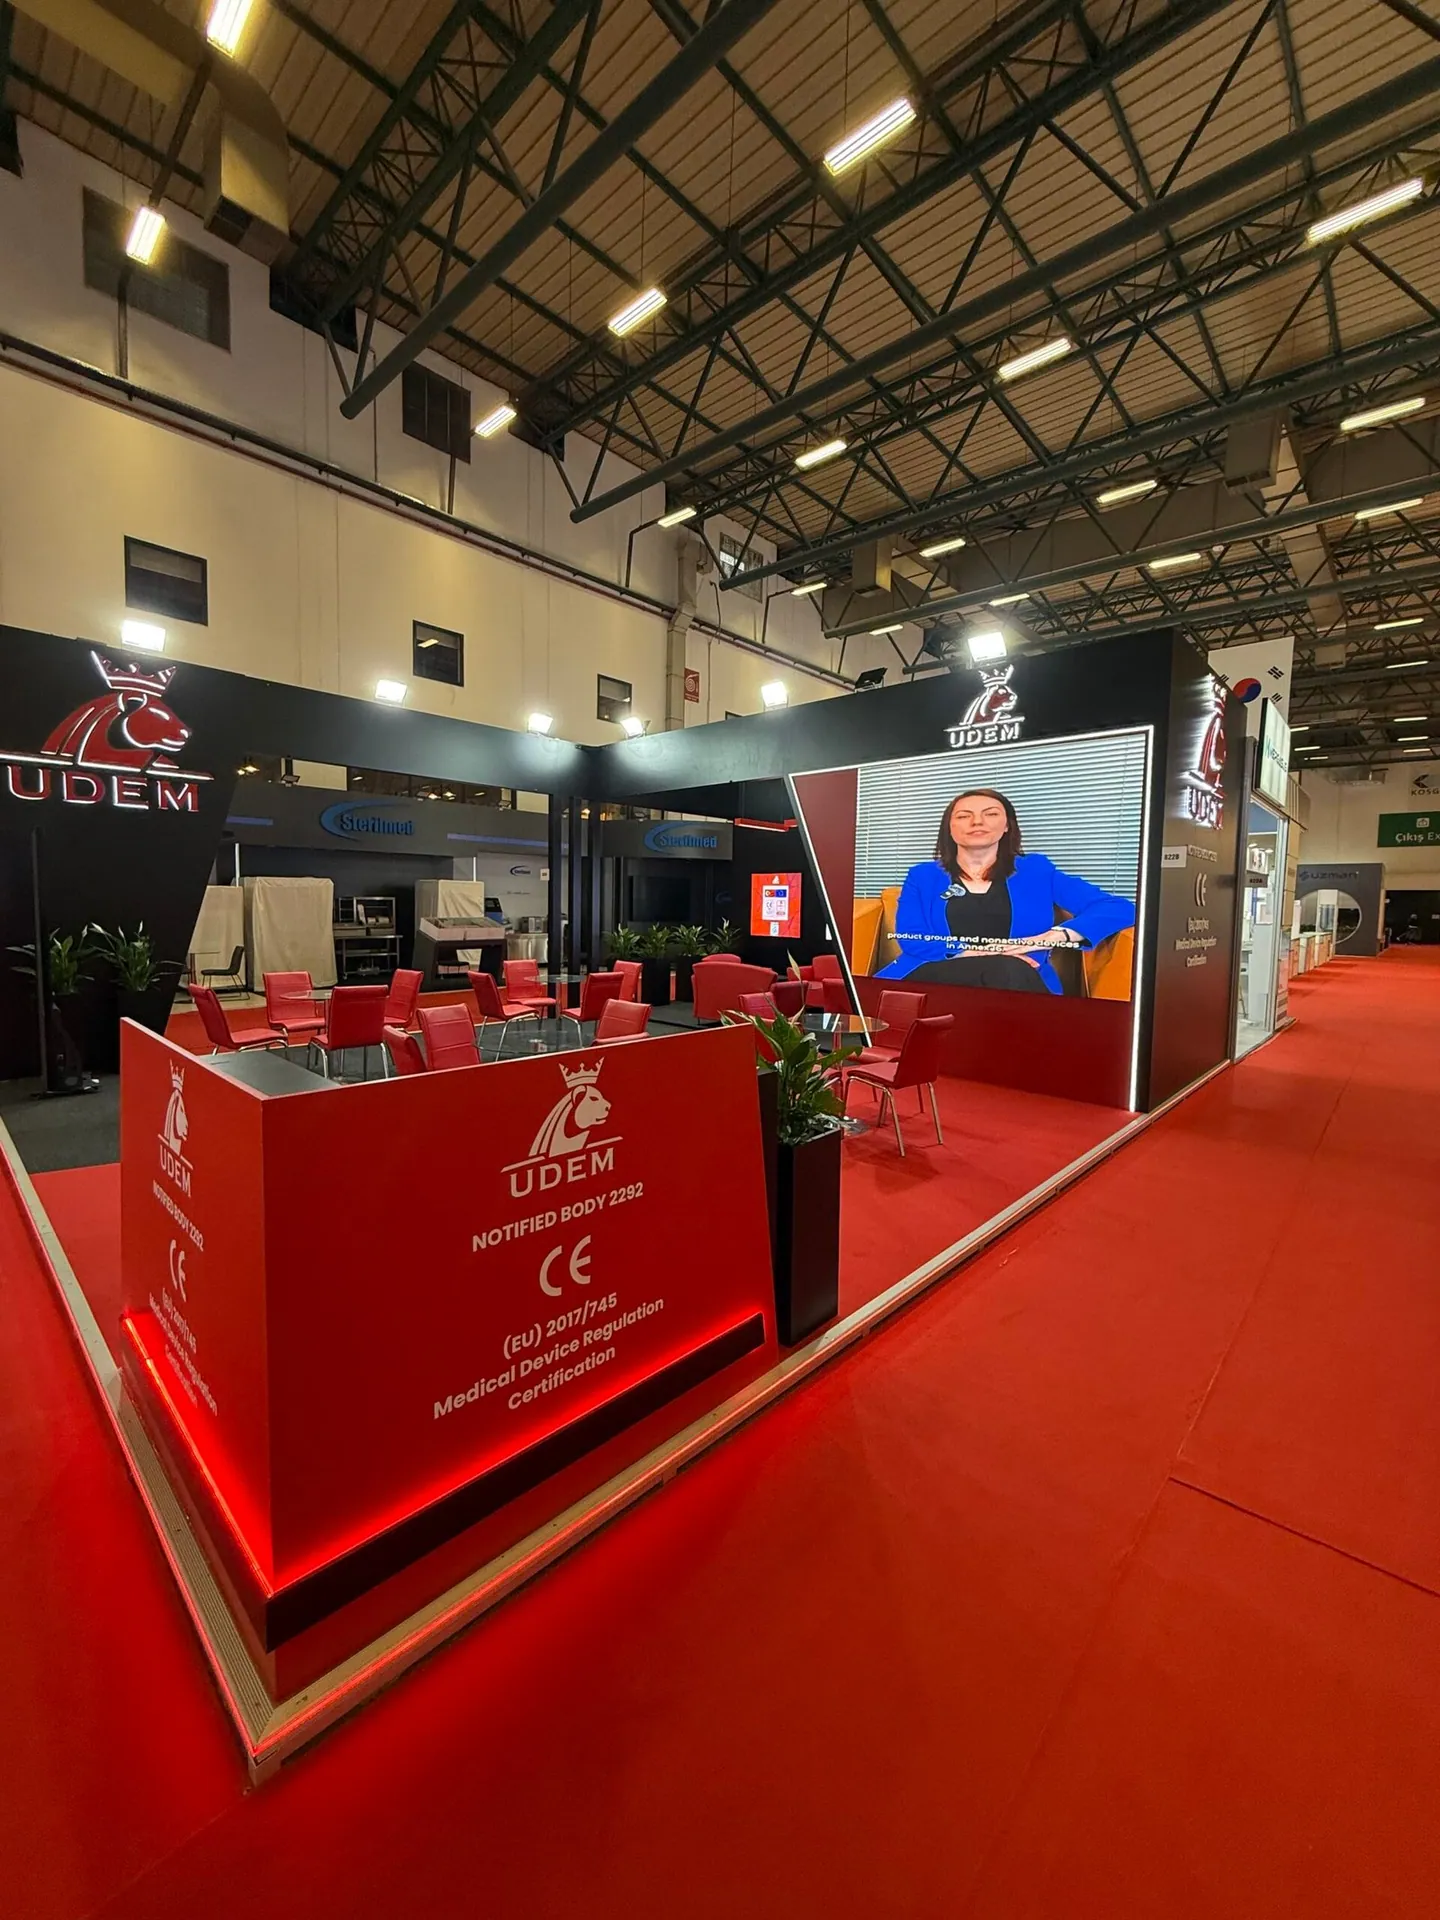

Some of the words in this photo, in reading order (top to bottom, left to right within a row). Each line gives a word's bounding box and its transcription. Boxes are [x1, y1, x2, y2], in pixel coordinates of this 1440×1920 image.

[950, 722, 1020, 748] UDEM
[7, 765, 200, 813] UDEM
[1395, 833, 1424, 843] Çıkış
[887, 932, 922, 940] product
[924, 934, 957, 942] groups
[981, 937, 1034, 946] nonactive
[1036, 940, 1079, 948] devices
[160, 1144, 191, 1198] UDEM
[510, 1147, 614, 1198] UDEM
[472, 1211, 557, 1252] NOTIFIED
[560, 1194, 607, 1223] BODY
[609, 1181, 644, 1206] 2292
[169, 1239, 186, 1302] CE
[539, 1234, 591, 1297] CE
[503, 1323, 542, 1360] (EU)
[546, 1292, 618, 1338] 2017/745
[433, 1365, 516, 1420] Medical
[519, 1338, 580, 1377] Device
[583, 1298, 664, 1347] Regulation
[507, 1346, 616, 1410] Certification
